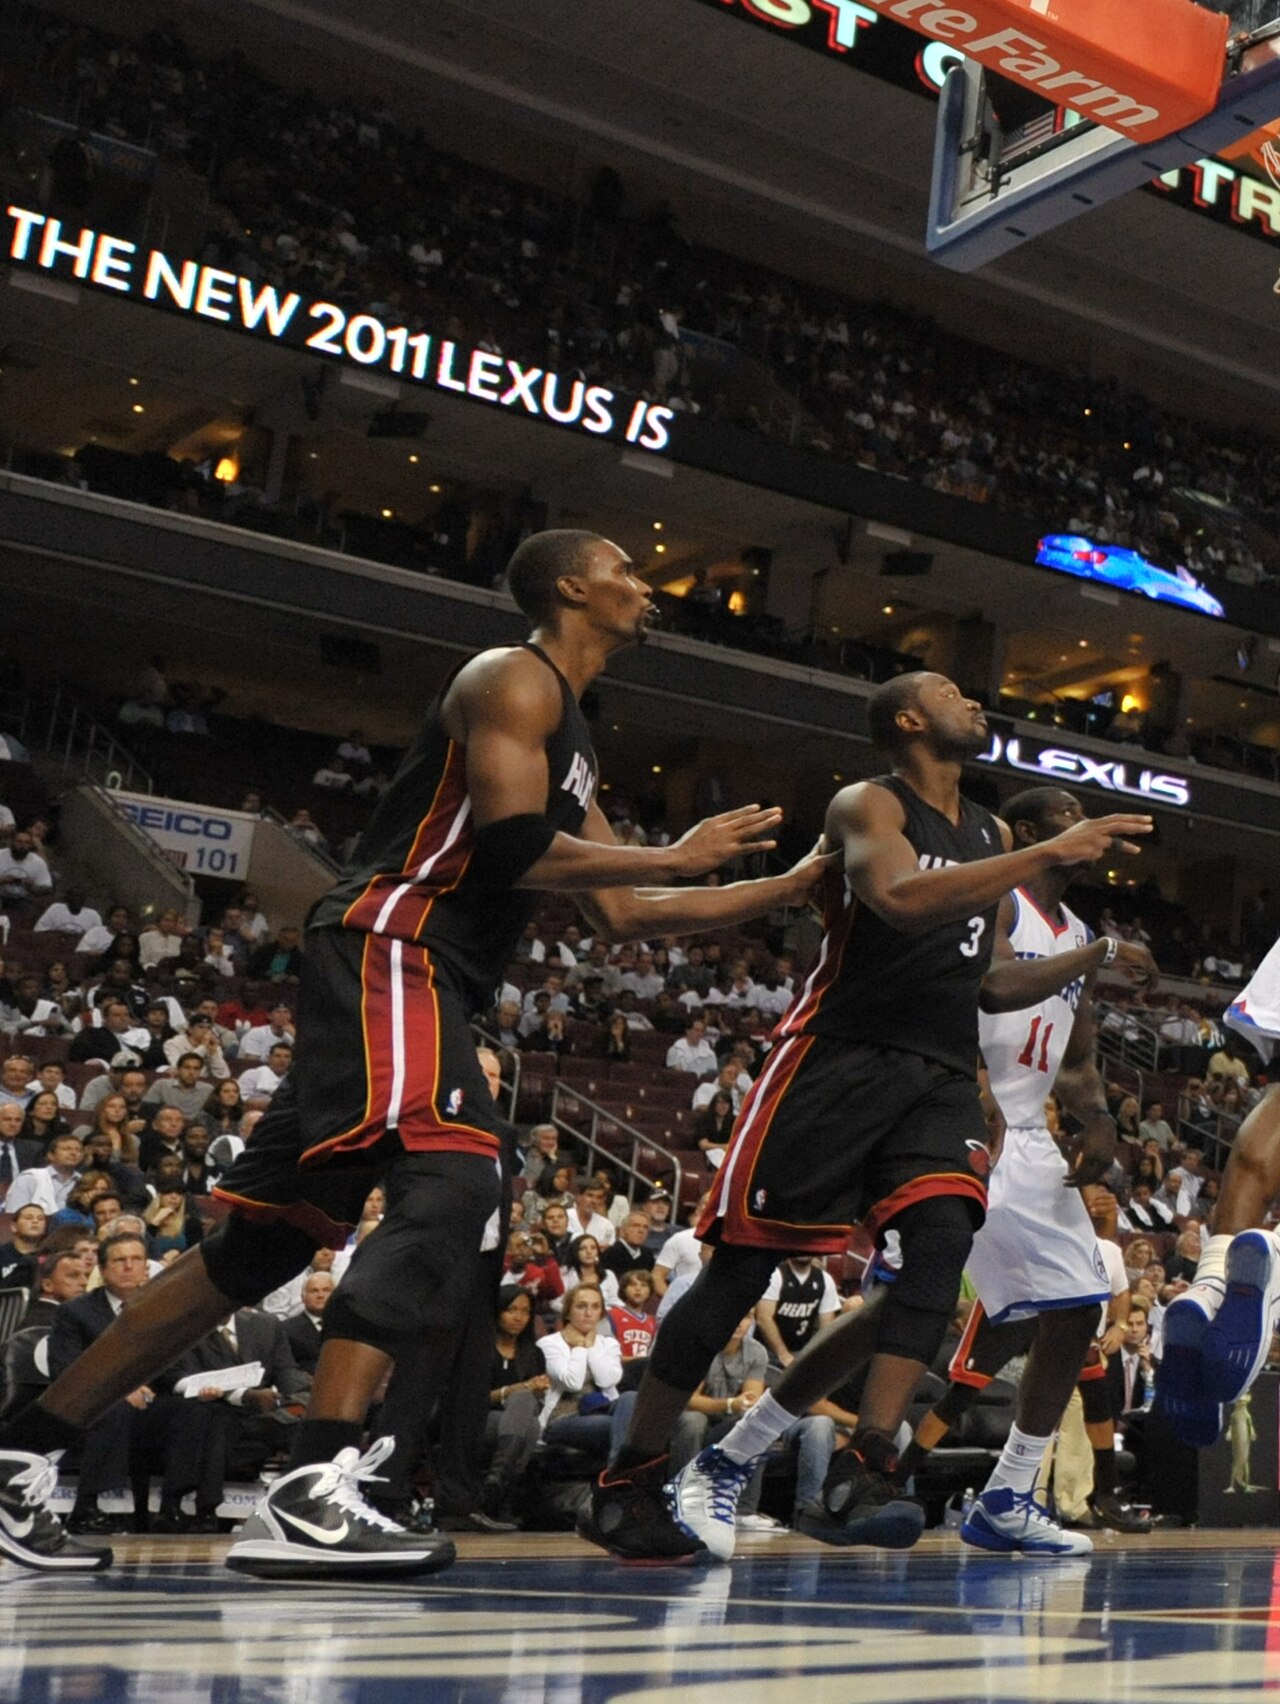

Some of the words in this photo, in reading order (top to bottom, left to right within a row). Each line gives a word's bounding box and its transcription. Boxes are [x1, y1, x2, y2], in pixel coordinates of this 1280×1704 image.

[962, 27, 1159, 128] Farm
[7, 204, 136, 292] THE
[143, 249, 301, 337] NEW
[305, 301, 431, 380] 2011
[437, 340, 615, 433] LEXUS
[625, 400, 675, 450] IS
[1006, 738, 1190, 806] LEXUS
[196, 847, 238, 874] 101
[959, 915, 985, 957] 3
[1017, 1015, 1054, 1075] 11
[777, 1298, 820, 1318] HEAT
[795, 1320, 810, 1337] 3
